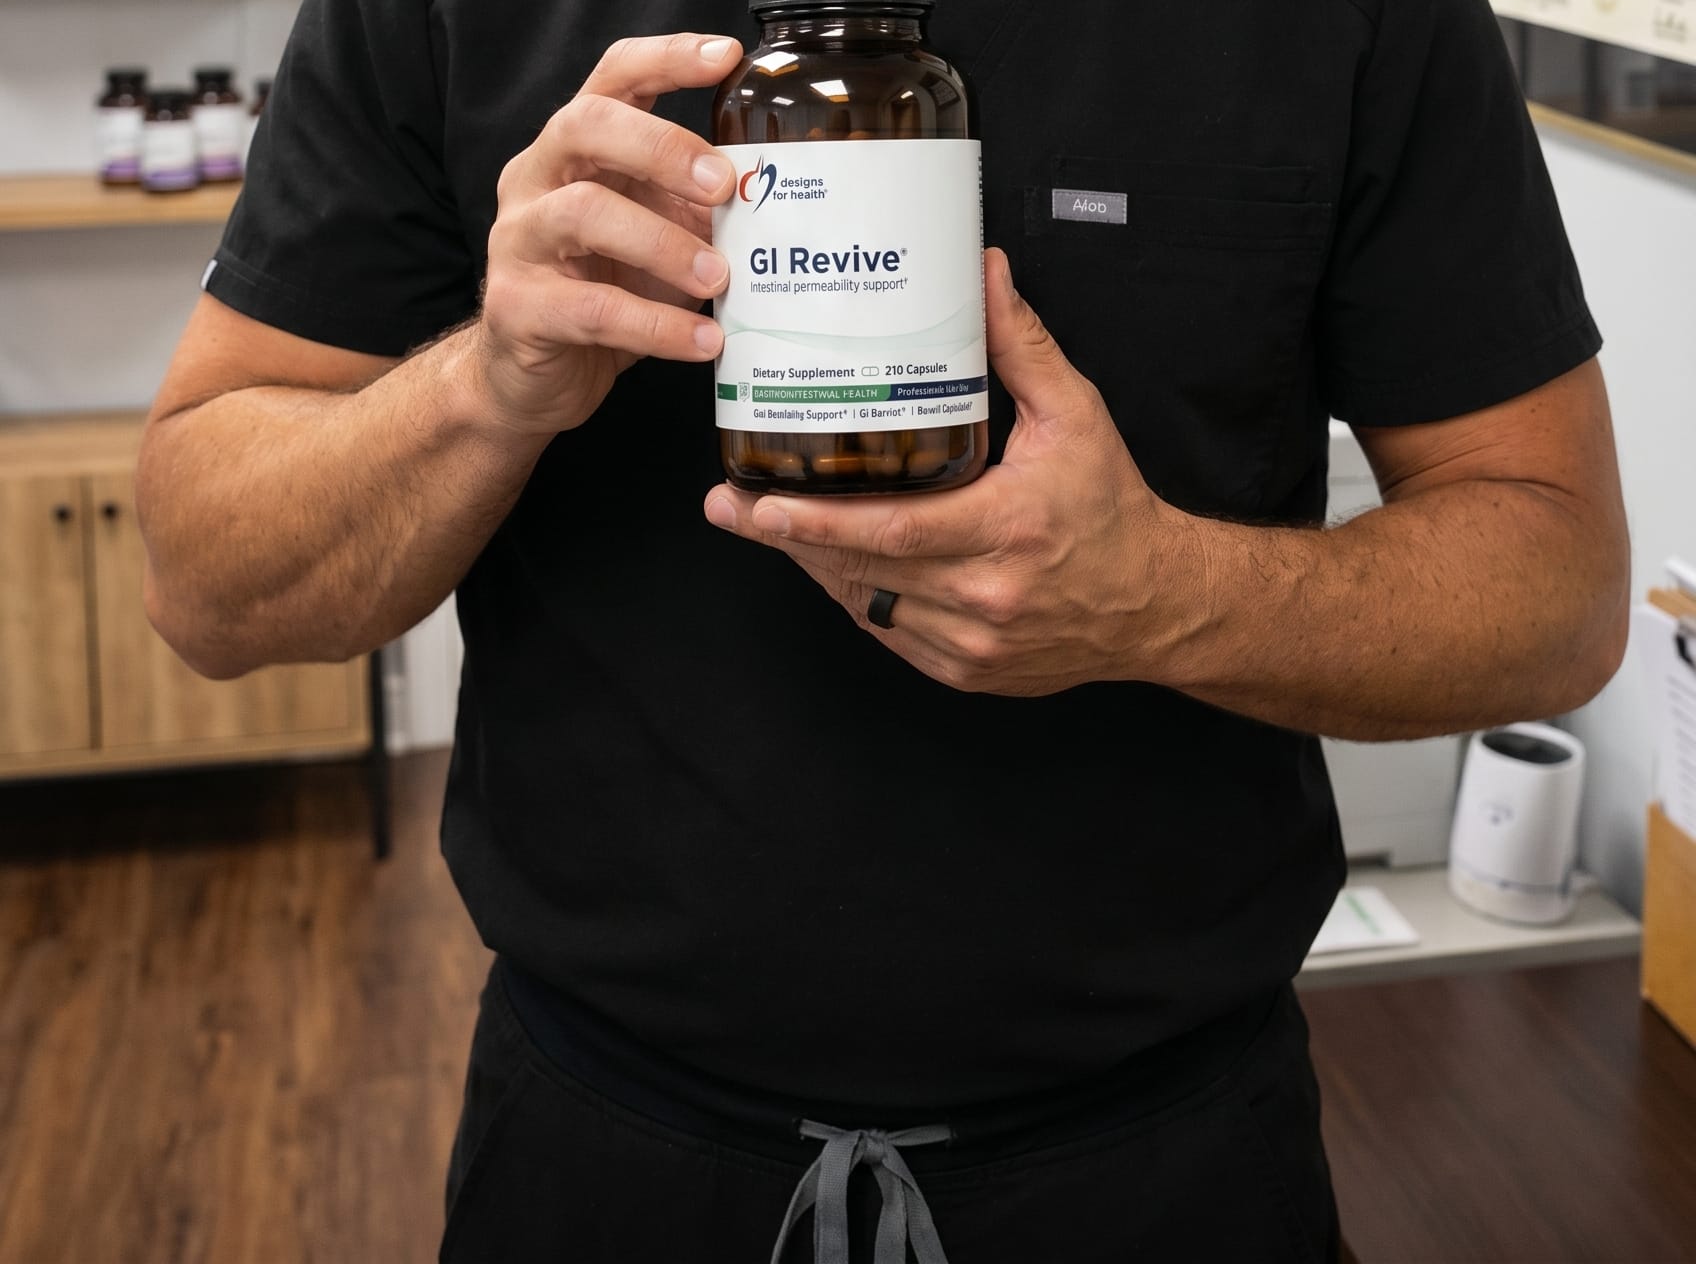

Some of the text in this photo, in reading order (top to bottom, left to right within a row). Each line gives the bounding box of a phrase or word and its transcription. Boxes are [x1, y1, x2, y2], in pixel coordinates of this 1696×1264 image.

[780, 177, 824, 189] designs
[773, 190, 788, 200] for
[750, 247, 777, 275] GI
[750, 280, 791, 293] Intestinal
[794, 279, 860, 294] permeability
[753, 363, 948, 381] Dietary Supplement 210 Capsules
